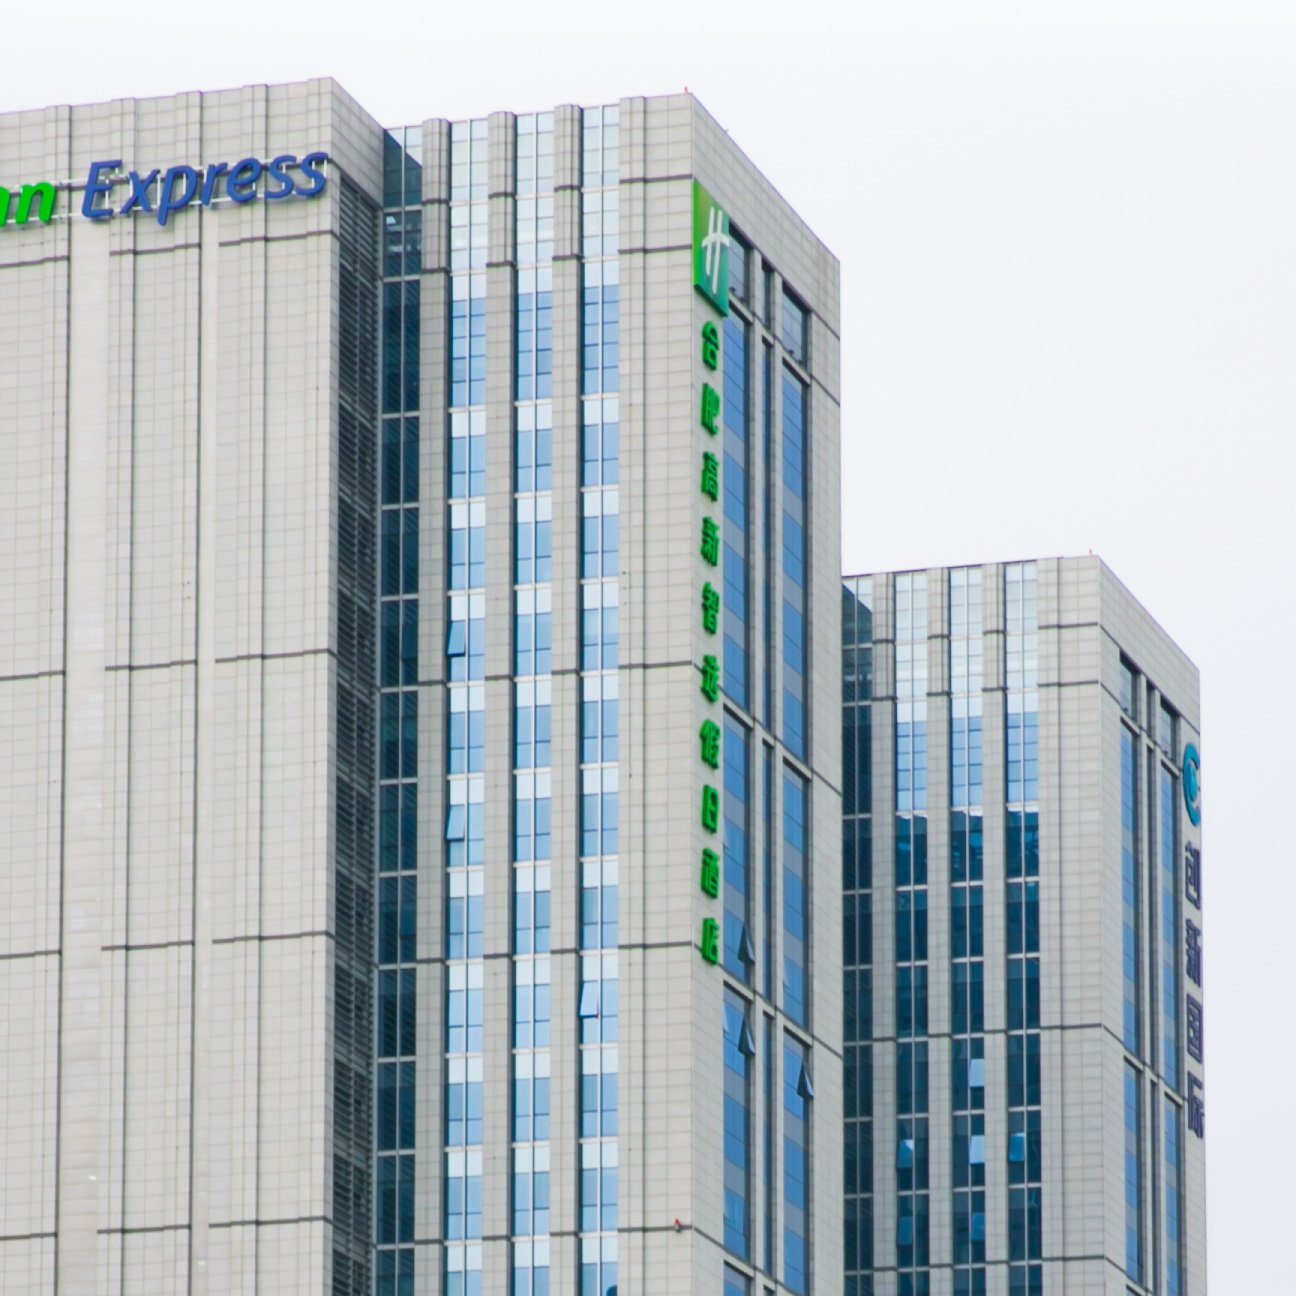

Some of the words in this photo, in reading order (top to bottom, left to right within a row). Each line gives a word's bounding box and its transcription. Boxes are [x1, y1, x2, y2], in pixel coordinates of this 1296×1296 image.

[81, 151, 329, 226] Express
[700, 321, 720, 965] 合肥高新智选假日酒店
